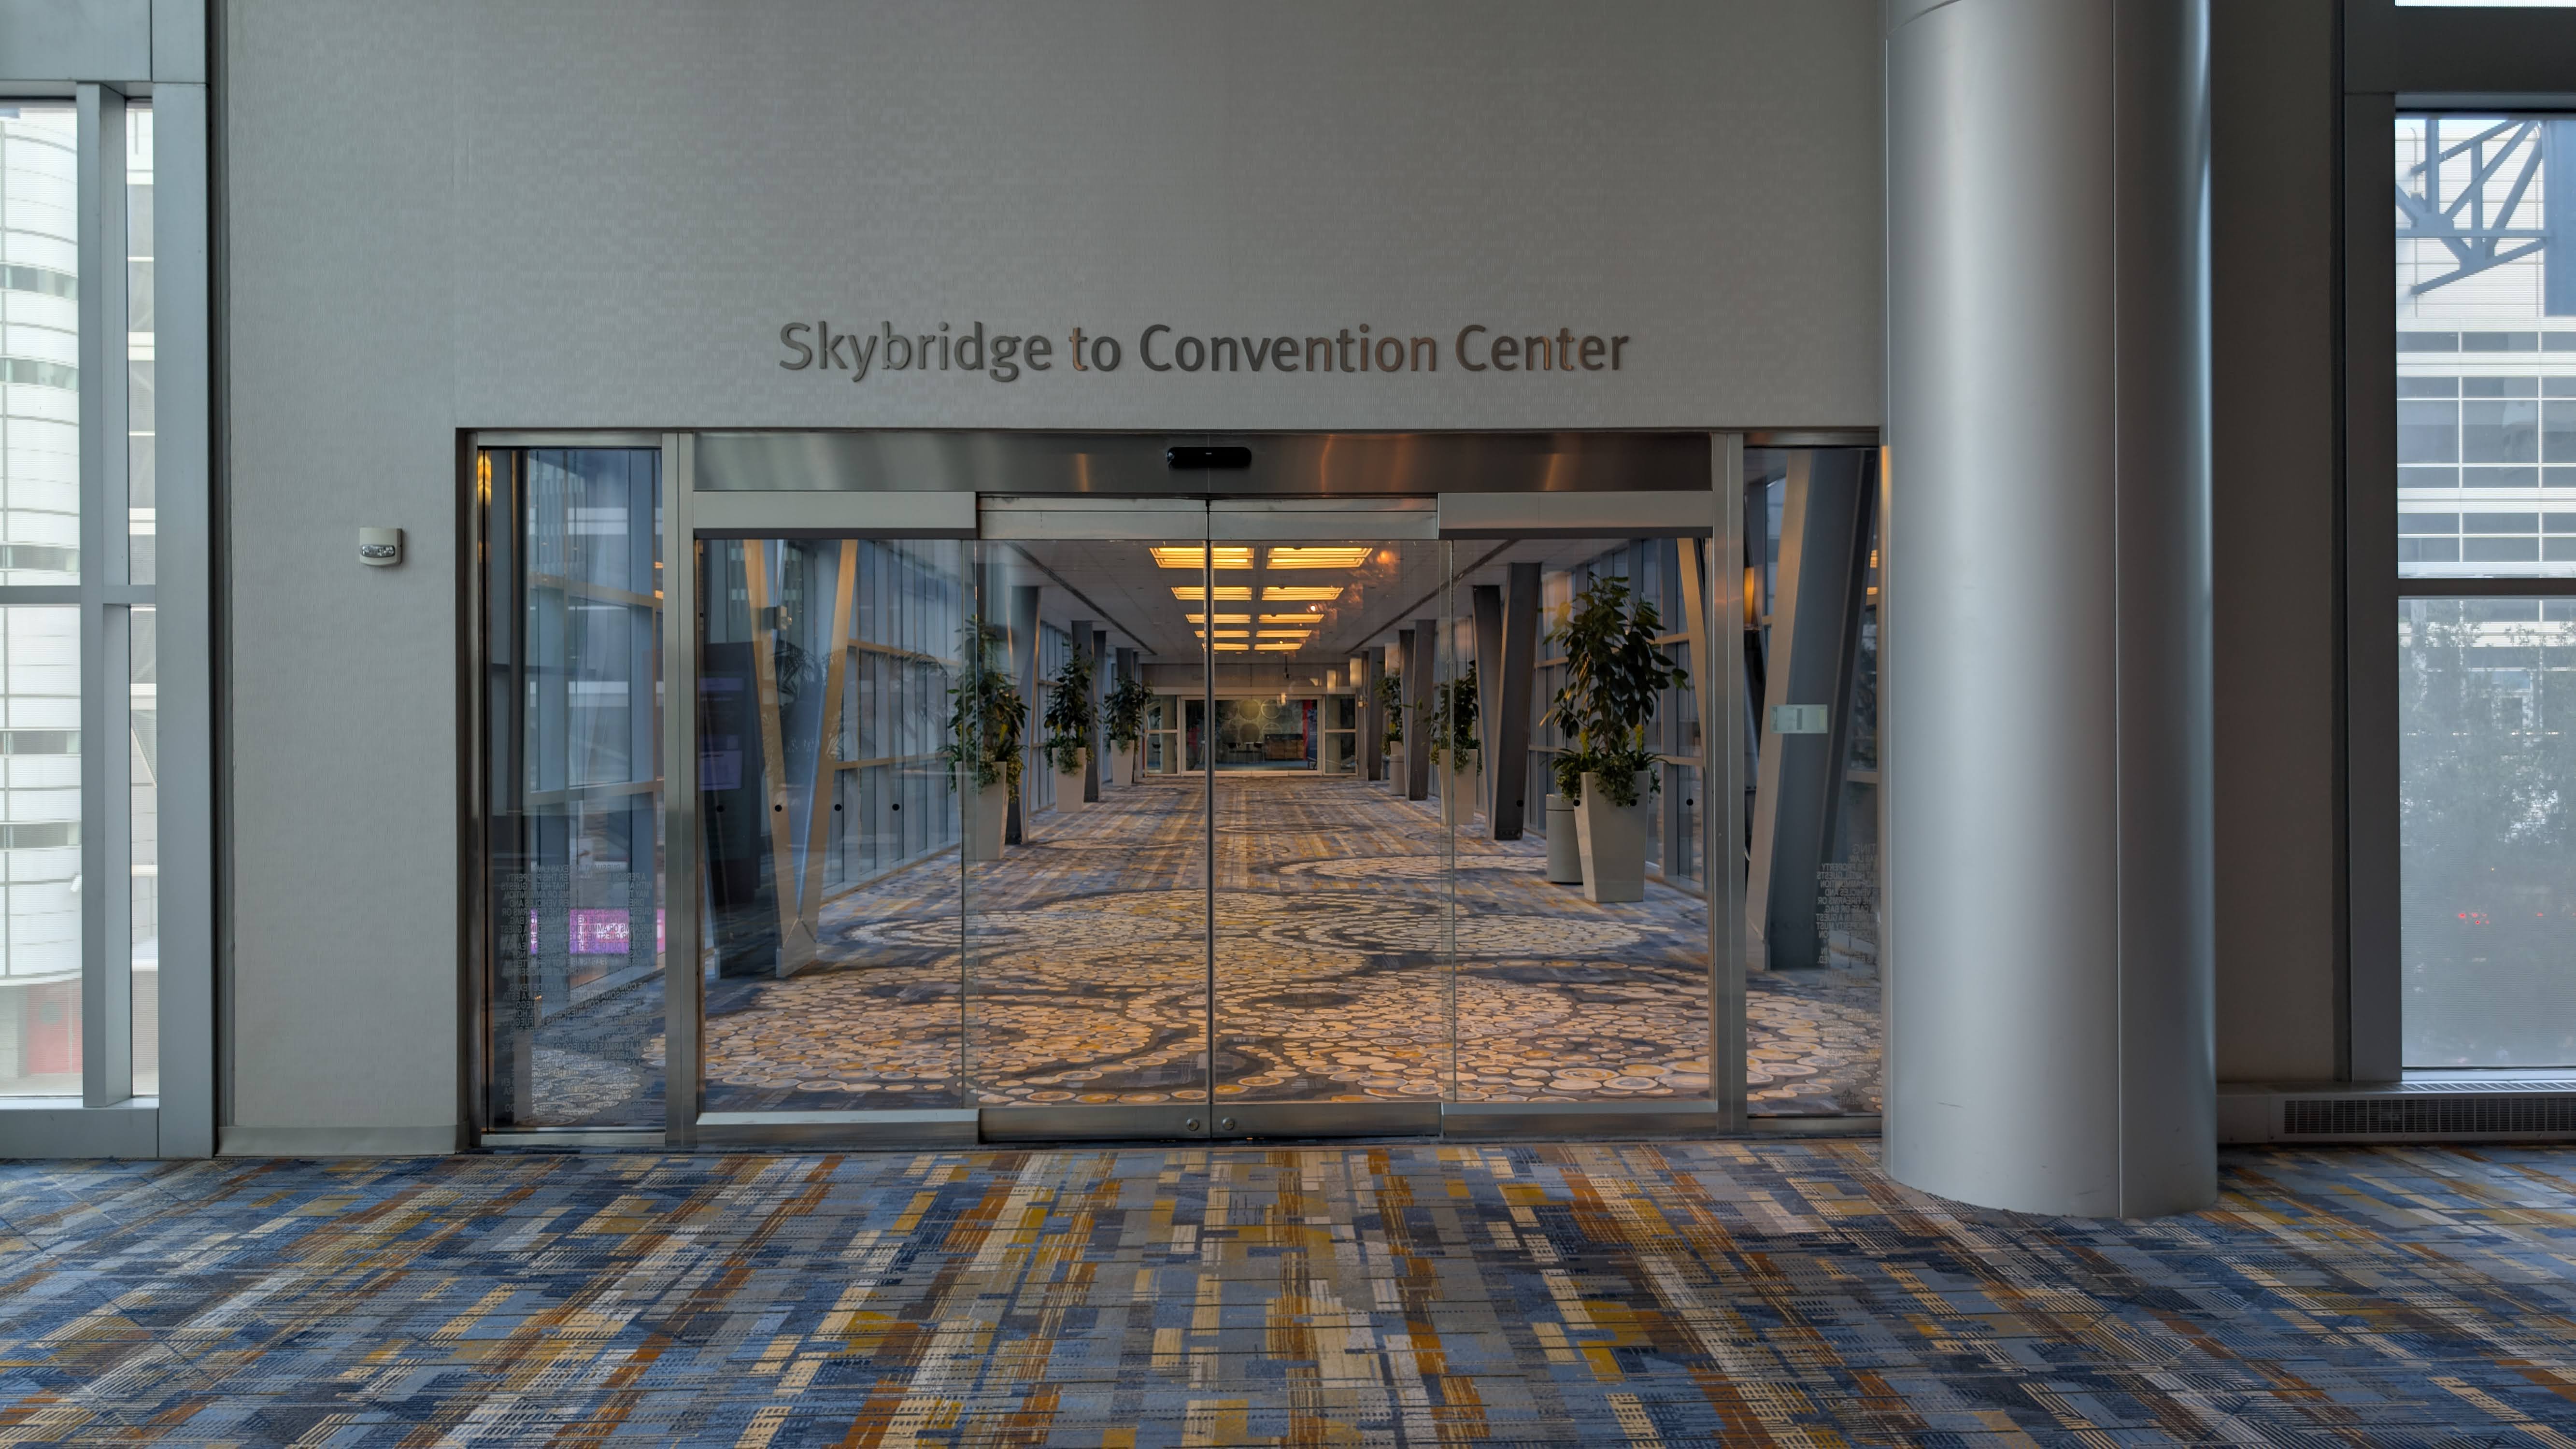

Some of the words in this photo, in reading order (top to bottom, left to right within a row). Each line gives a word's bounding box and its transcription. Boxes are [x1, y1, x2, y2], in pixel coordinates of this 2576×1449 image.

[779, 320, 1053, 384] Skybridge
[1068, 327, 1122, 372] to
[1139, 323, 1437, 373] Convention
[1455, 324, 1631, 372] Center
